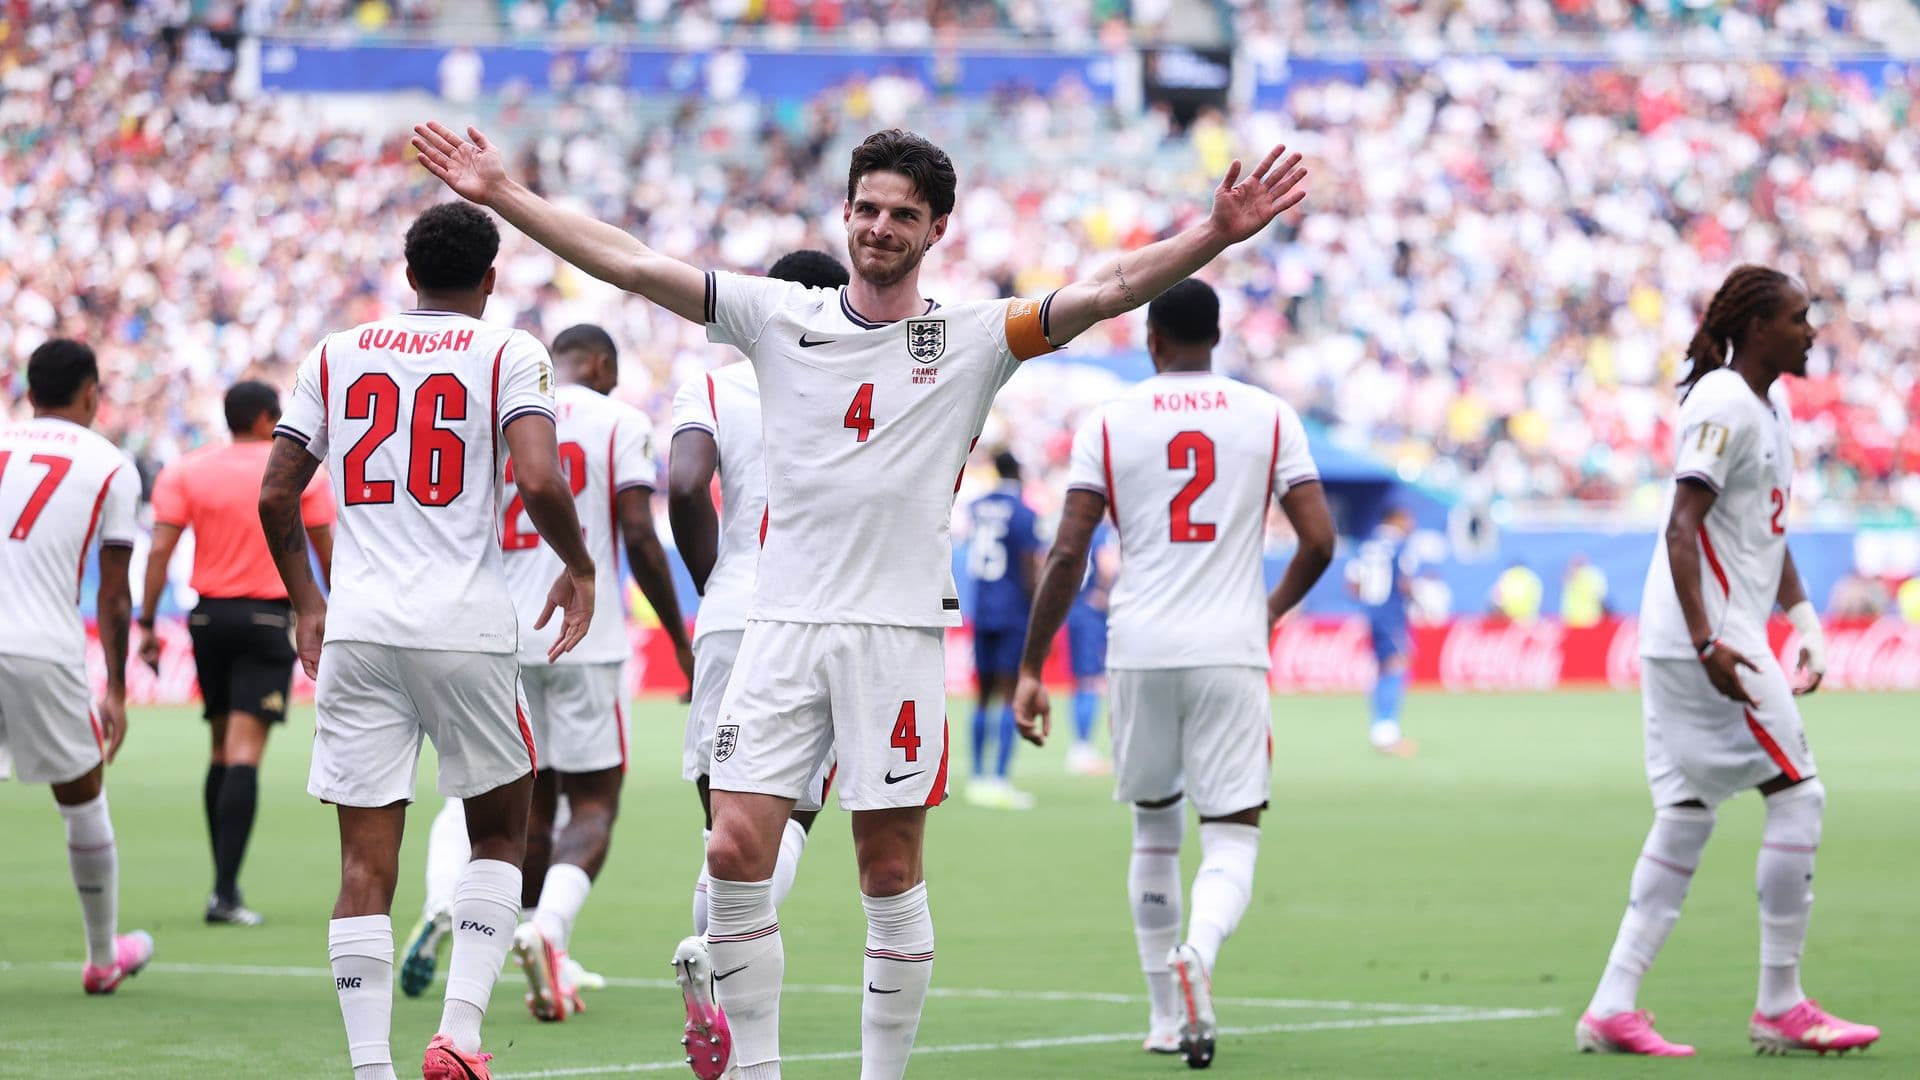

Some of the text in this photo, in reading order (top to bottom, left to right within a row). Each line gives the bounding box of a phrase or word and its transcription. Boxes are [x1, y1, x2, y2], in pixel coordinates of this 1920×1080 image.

[358, 328, 475, 354] QUANSAH
[911, 367, 938, 376] FRANCE
[843, 382, 875, 443] 4
[1153, 391, 1229, 412] KONSA
[343, 372, 467, 507] 26
[0, 450, 73, 542] 7
[1167, 430, 1216, 543] 2
[890, 700, 921, 762] 4
[459, 920, 496, 937] ENG
[336, 976, 362, 991] ENG
